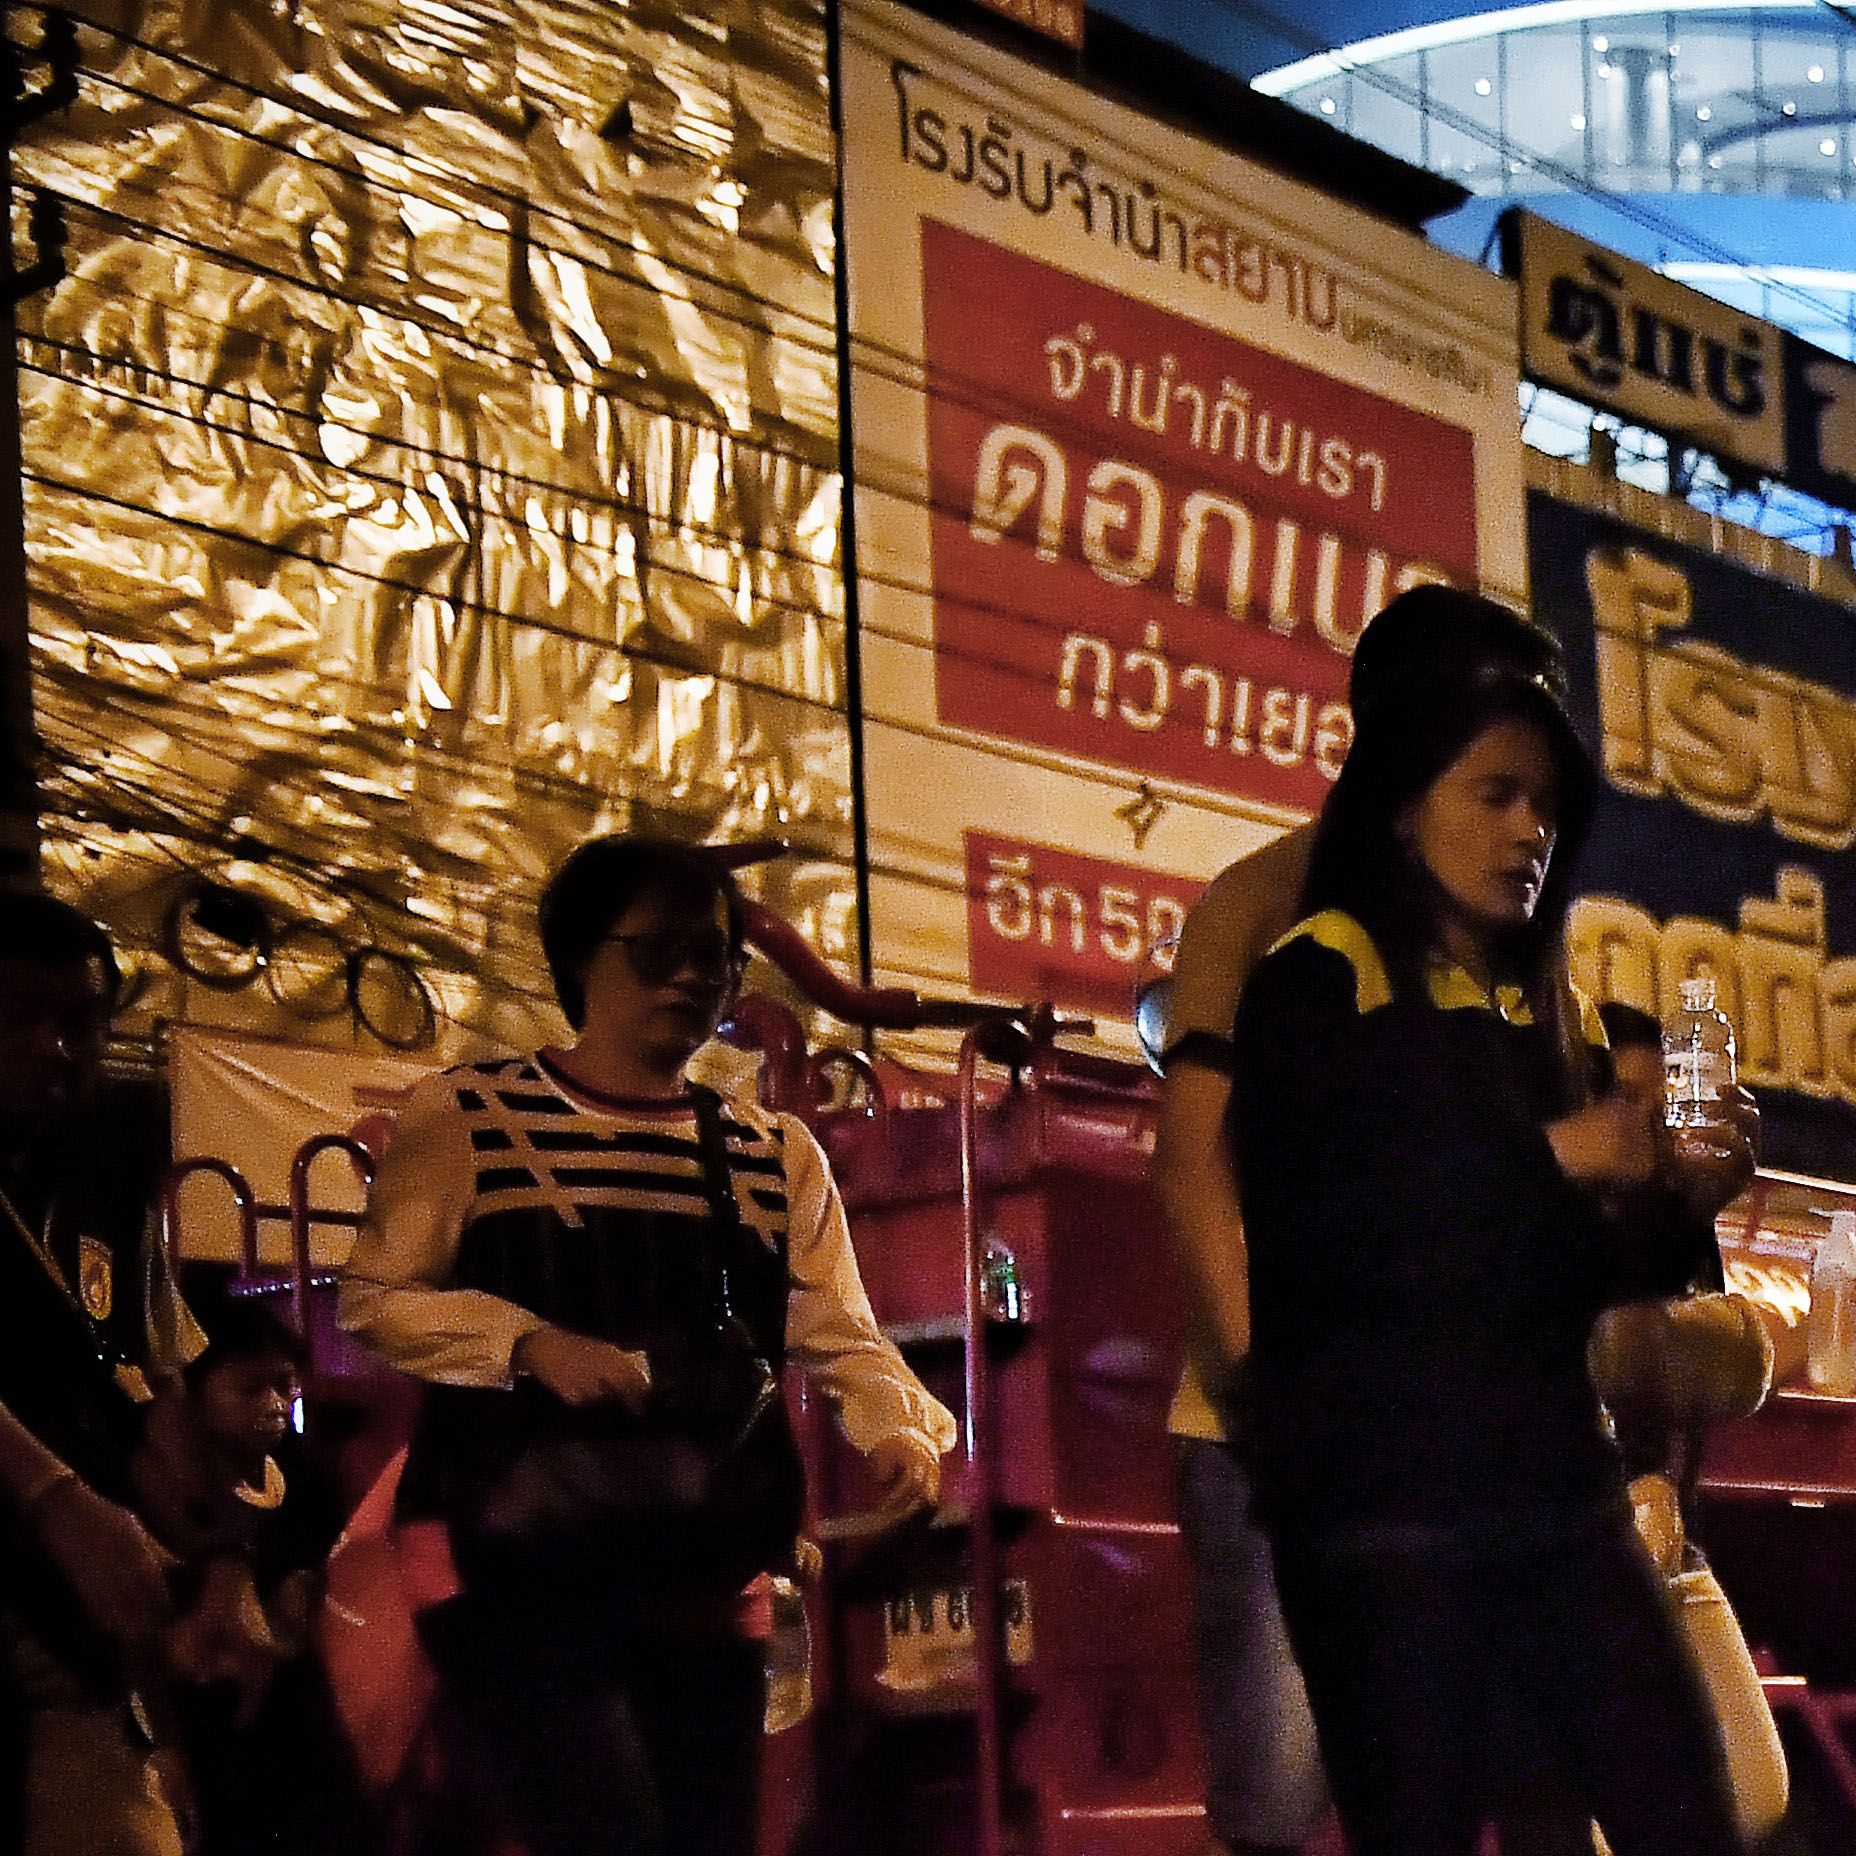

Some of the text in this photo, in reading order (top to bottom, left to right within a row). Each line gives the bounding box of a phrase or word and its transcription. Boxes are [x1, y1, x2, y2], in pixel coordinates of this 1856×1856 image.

[1043, 323, 1386, 513] จำนำกับเรา
[1055, 619, 1358, 782] กว่าเยอ
